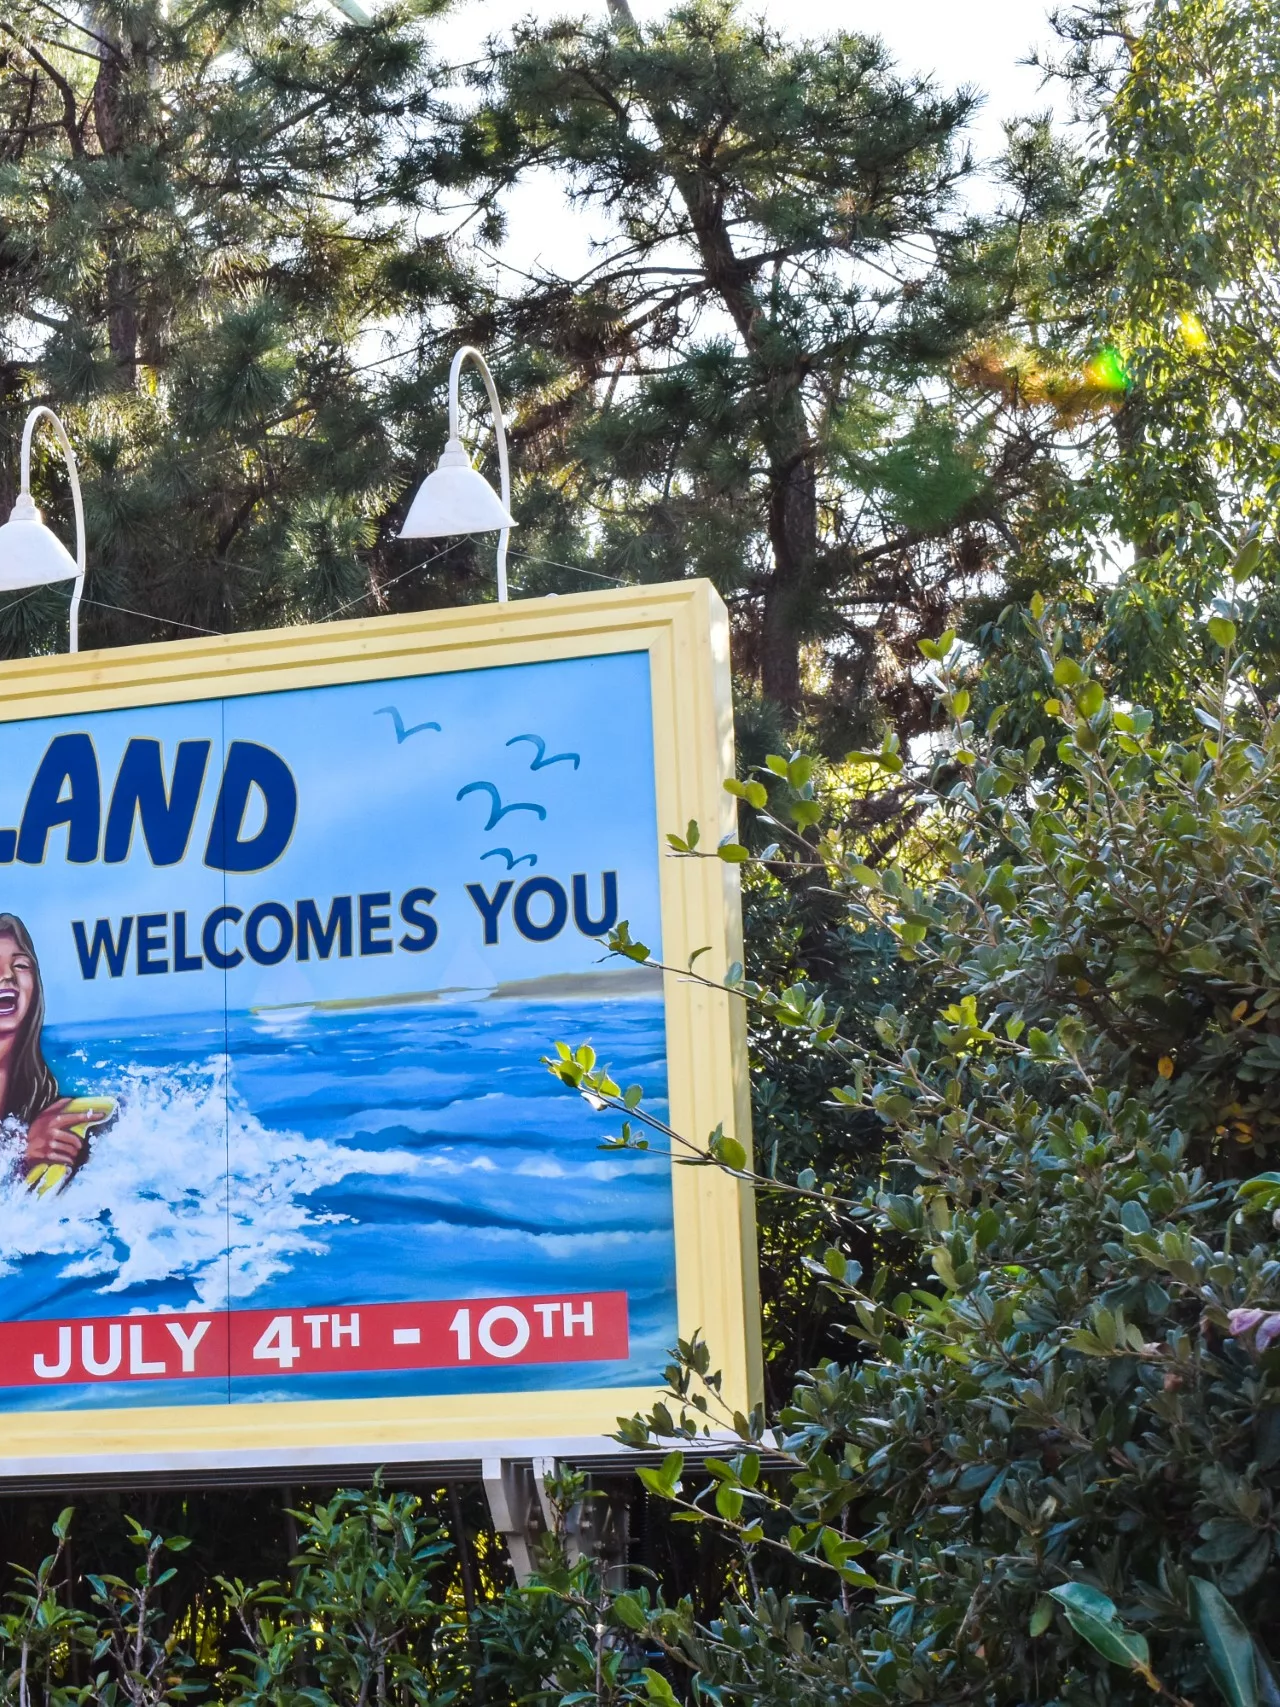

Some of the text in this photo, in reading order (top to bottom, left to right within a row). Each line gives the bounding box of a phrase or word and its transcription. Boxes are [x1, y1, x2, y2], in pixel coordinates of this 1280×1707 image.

[71, 869, 619, 981] WELCOMES YOU
[32, 1320, 212, 1379] JULY
[252, 1312, 361, 1368] 4TH
[448, 1301, 595, 1361] 10TH
